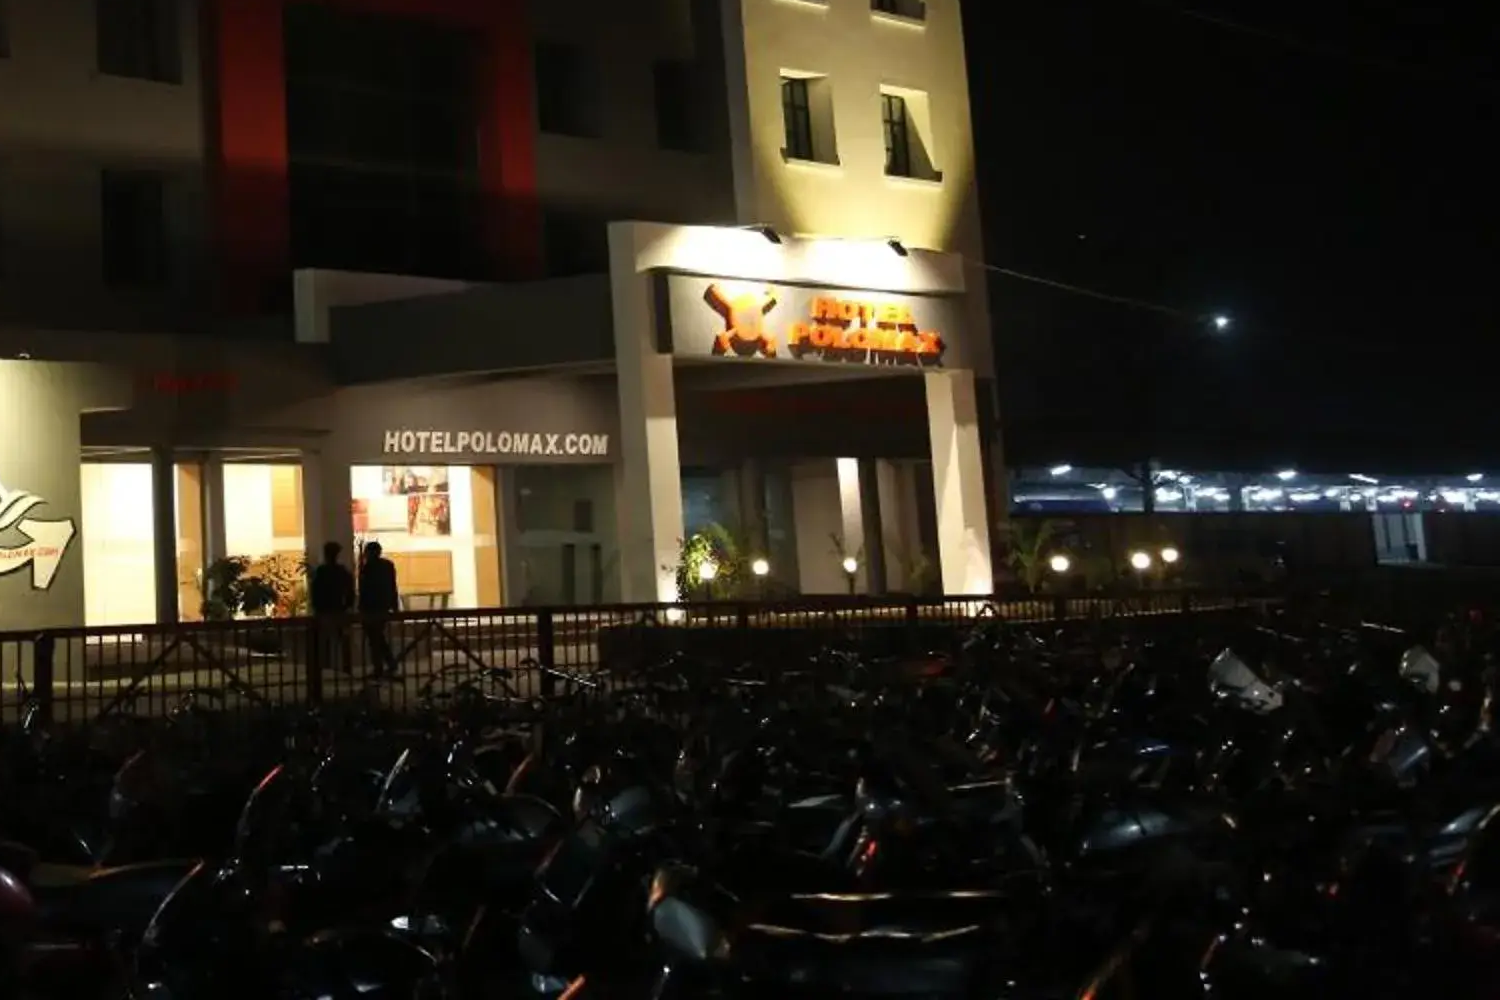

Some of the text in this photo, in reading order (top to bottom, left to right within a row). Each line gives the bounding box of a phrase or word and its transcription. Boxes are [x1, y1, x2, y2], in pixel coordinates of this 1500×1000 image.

[810, 297, 916, 330] HOTEL
[787, 322, 944, 362] POLOMAX
[383, 430, 610, 456] HOTELPOLOMAX.COM
